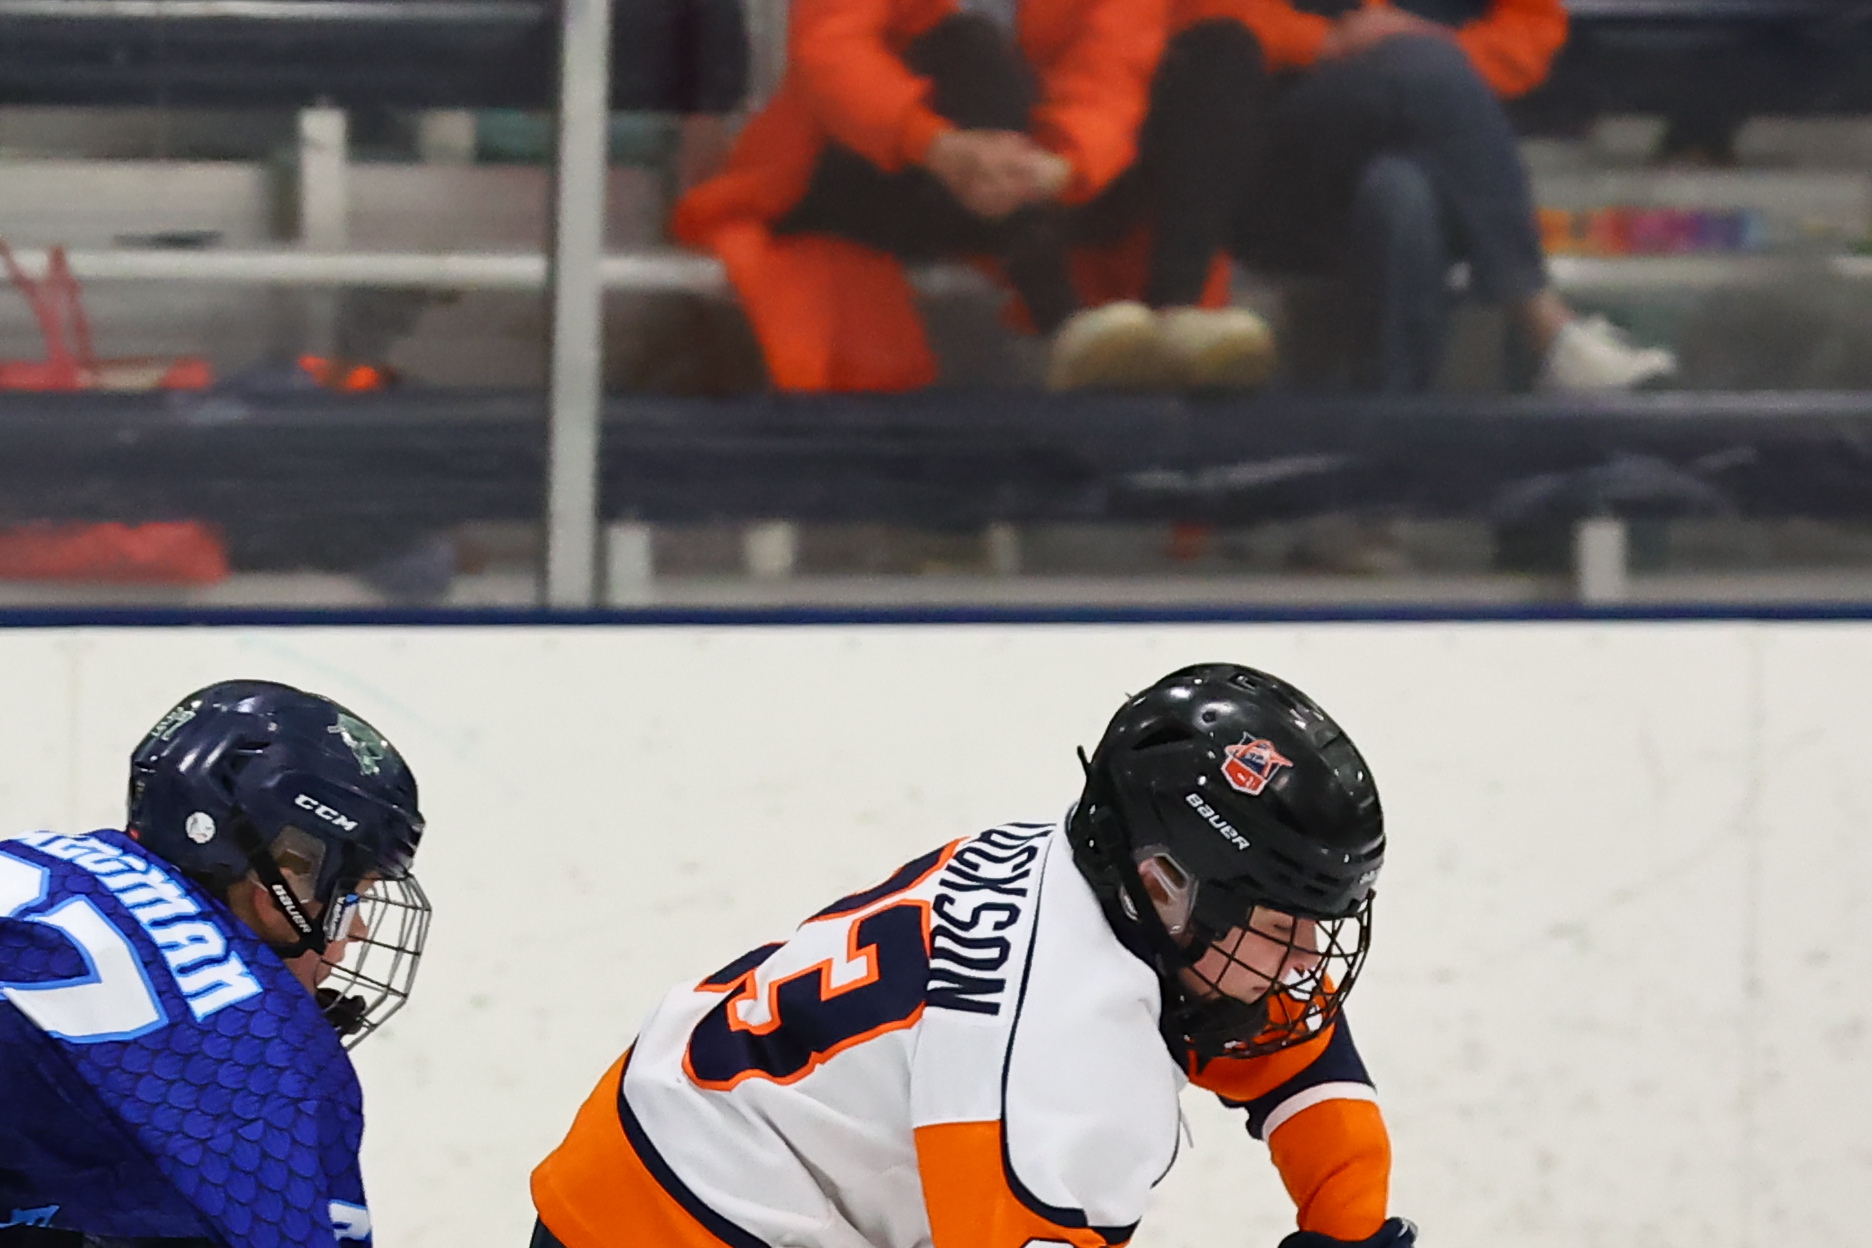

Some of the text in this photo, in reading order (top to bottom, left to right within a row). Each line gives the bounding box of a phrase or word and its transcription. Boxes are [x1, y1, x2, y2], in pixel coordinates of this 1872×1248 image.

[294, 793, 359, 832] CCM
[1186, 793, 1250, 850] BAUER
[271, 884, 312, 933] BAUER
